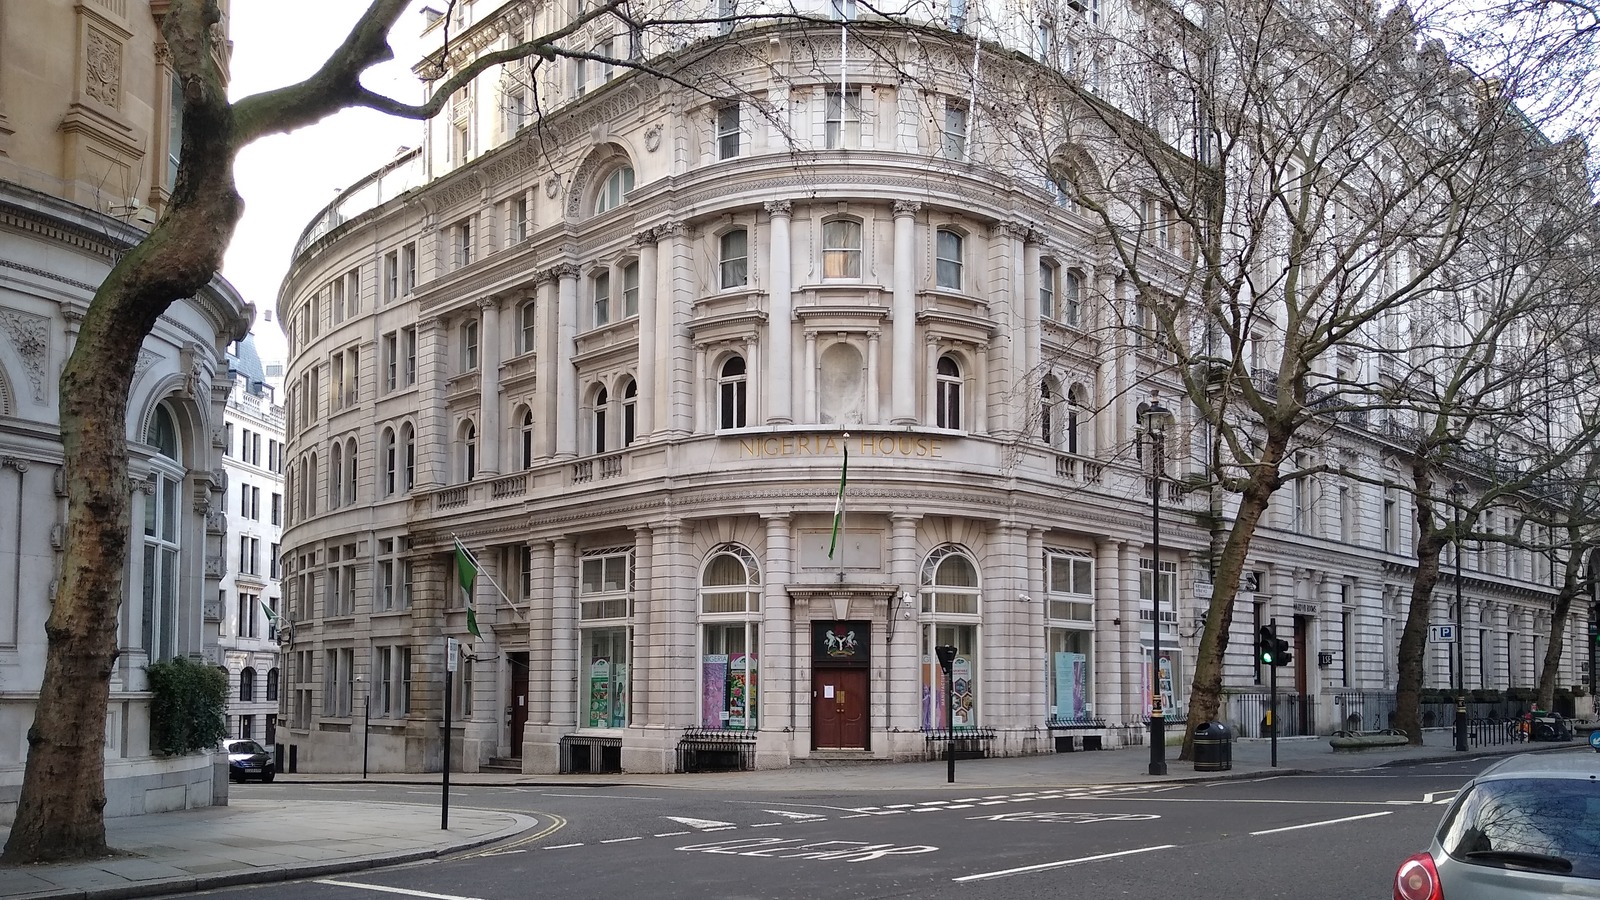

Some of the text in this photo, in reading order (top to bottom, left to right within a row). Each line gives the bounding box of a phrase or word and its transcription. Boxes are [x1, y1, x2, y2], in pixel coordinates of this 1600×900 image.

[739, 435, 943, 459] NIGERIA HOUSE
[1322, 655, 1331, 664] LSE
[964, 812, 1162, 824] KEEP
[675, 838, 940, 862] CLEAR
